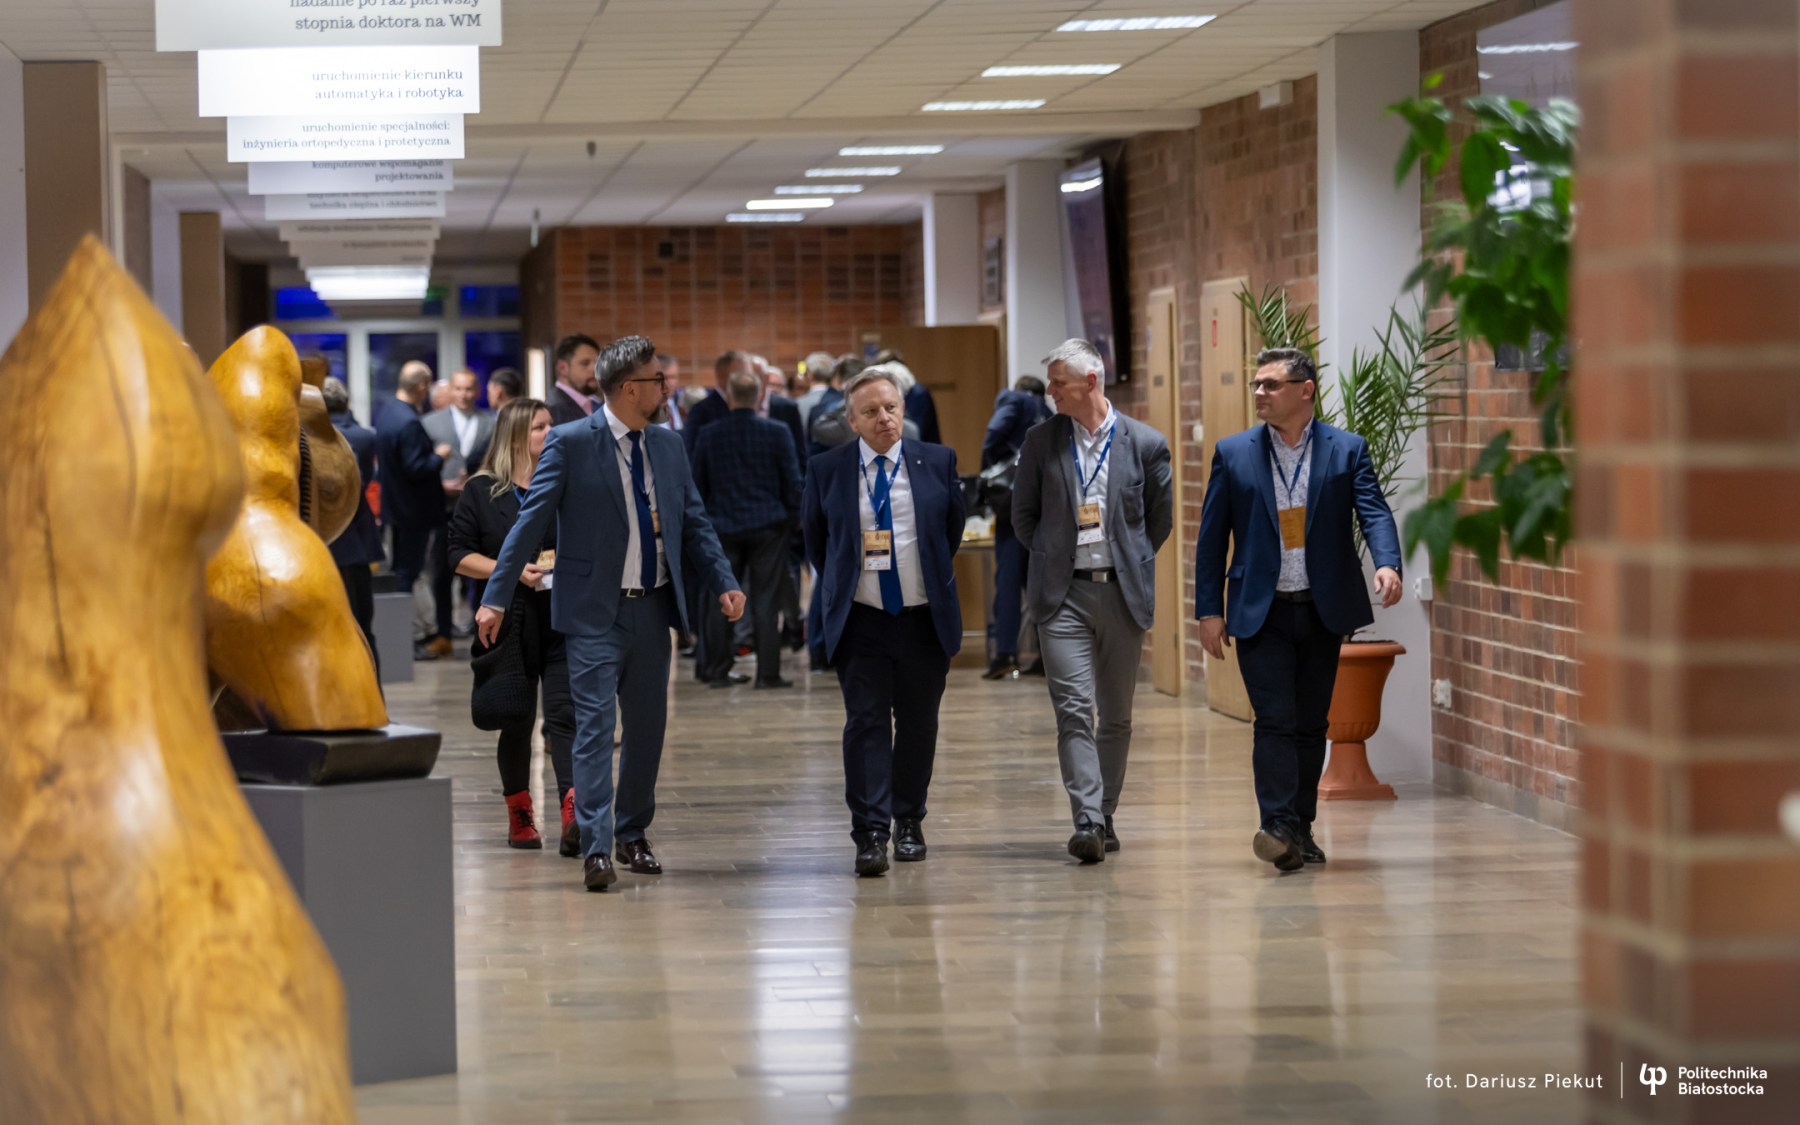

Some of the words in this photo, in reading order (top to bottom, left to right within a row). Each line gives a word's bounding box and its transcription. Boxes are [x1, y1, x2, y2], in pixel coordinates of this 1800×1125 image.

[296, 16, 355, 32] stopnia
[359, 16, 421, 28] doktora
[425, 18, 446, 27] na
[449, 14, 480, 26] WM
[313, 71, 400, 80] uruchomienie
[405, 69, 462, 79] kierunku
[316, 89, 393, 100] automatyka
[398, 88, 401, 98] i
[406, 87, 463, 100] robotyka
[302, 123, 377, 132] uruchomienie
[381, 120, 450, 132] specjalności:
[243, 139, 297, 150] inżynieria
[301, 138, 375, 149] ortopedyczna
[379, 137, 382, 146] i
[384, 136, 450, 149] protetyczna
[374, 170, 444, 183] projektowania
